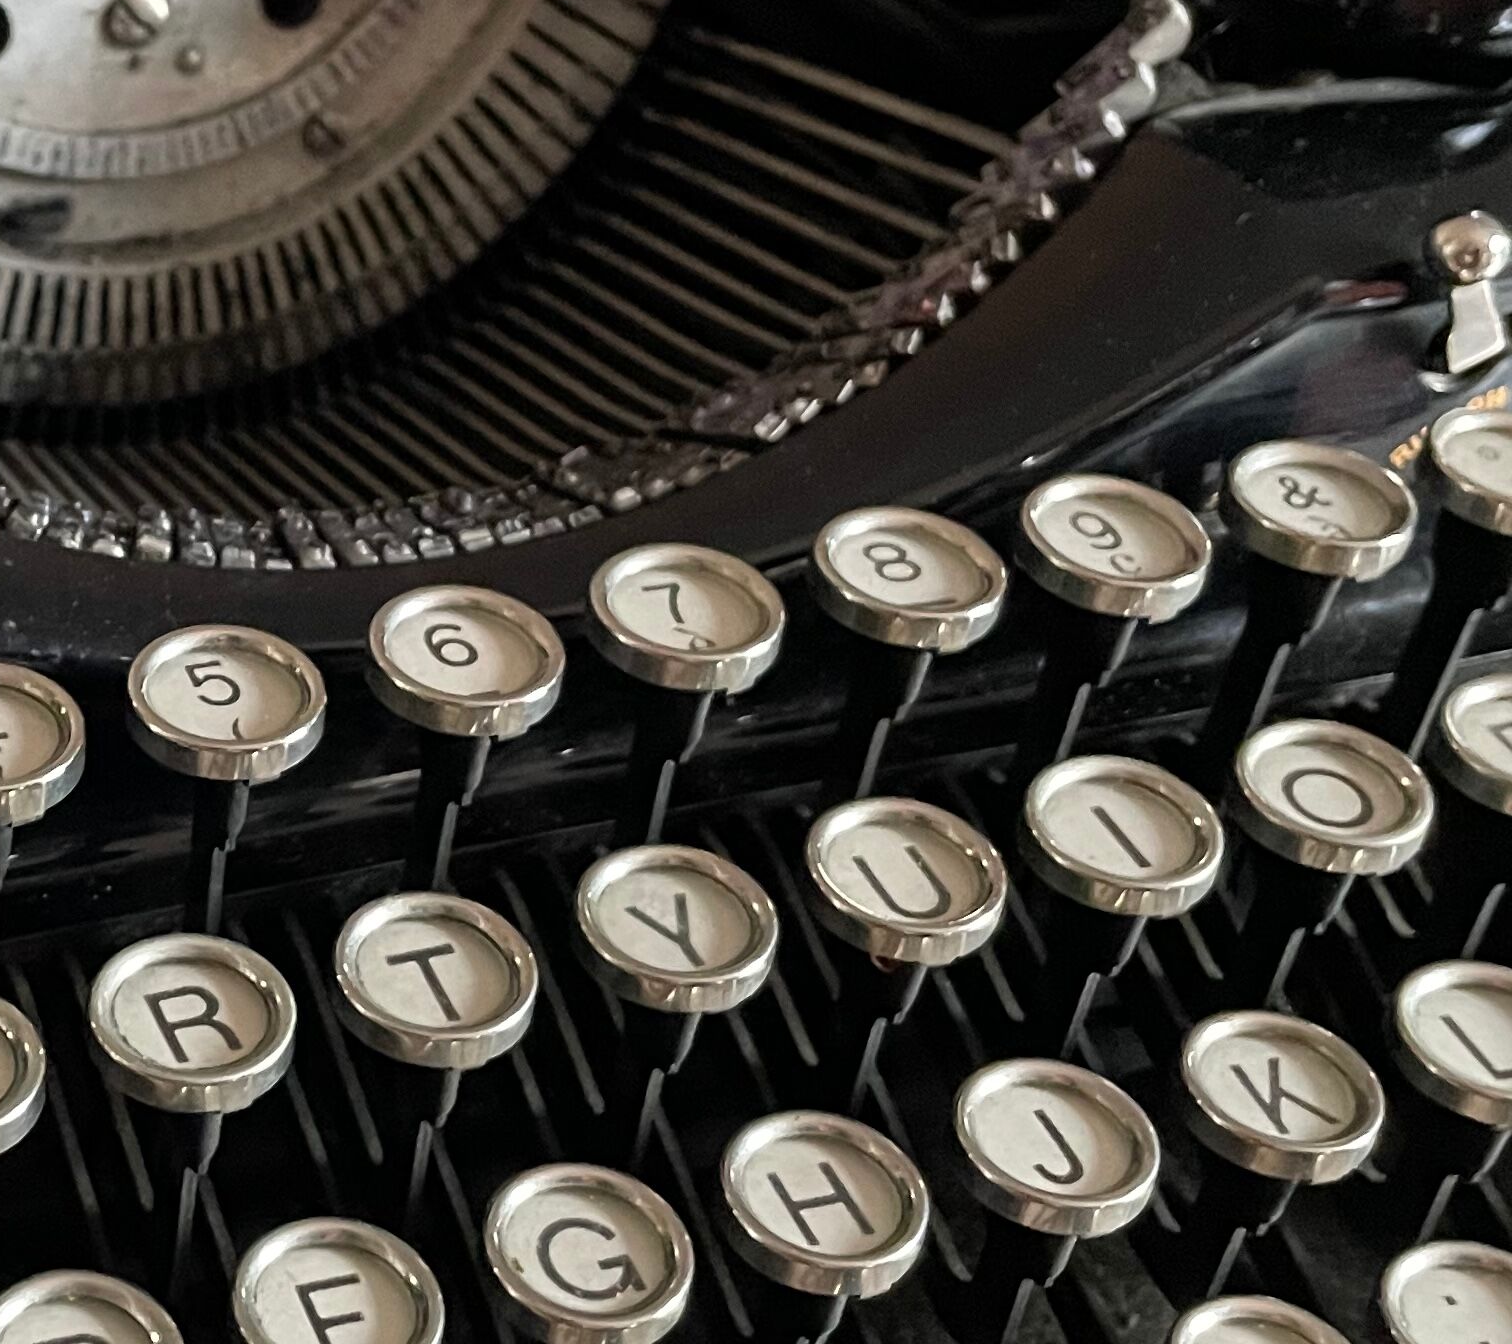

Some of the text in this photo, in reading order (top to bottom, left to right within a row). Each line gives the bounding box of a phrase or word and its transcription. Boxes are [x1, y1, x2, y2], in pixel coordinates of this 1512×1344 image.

[862, 542, 922, 583] 8
[1069, 511, 1123, 550] 9
[642, 582, 686, 625] 7
[184, 659, 242, 706] 5
[423, 623, 480, 668] 6
[1281, 768, 1375, 828] O
[1090, 804, 1153, 869] I
[852, 844, 952, 919] U
[624, 892, 706, 967] Y
[386, 943, 461, 1022] T
[144, 985, 244, 1064] R
[1229, 1056, 1341, 1135] K
[1033, 1108, 1085, 1184] J
[766, 1161, 876, 1247] H
[536, 1216, 648, 1300] G
